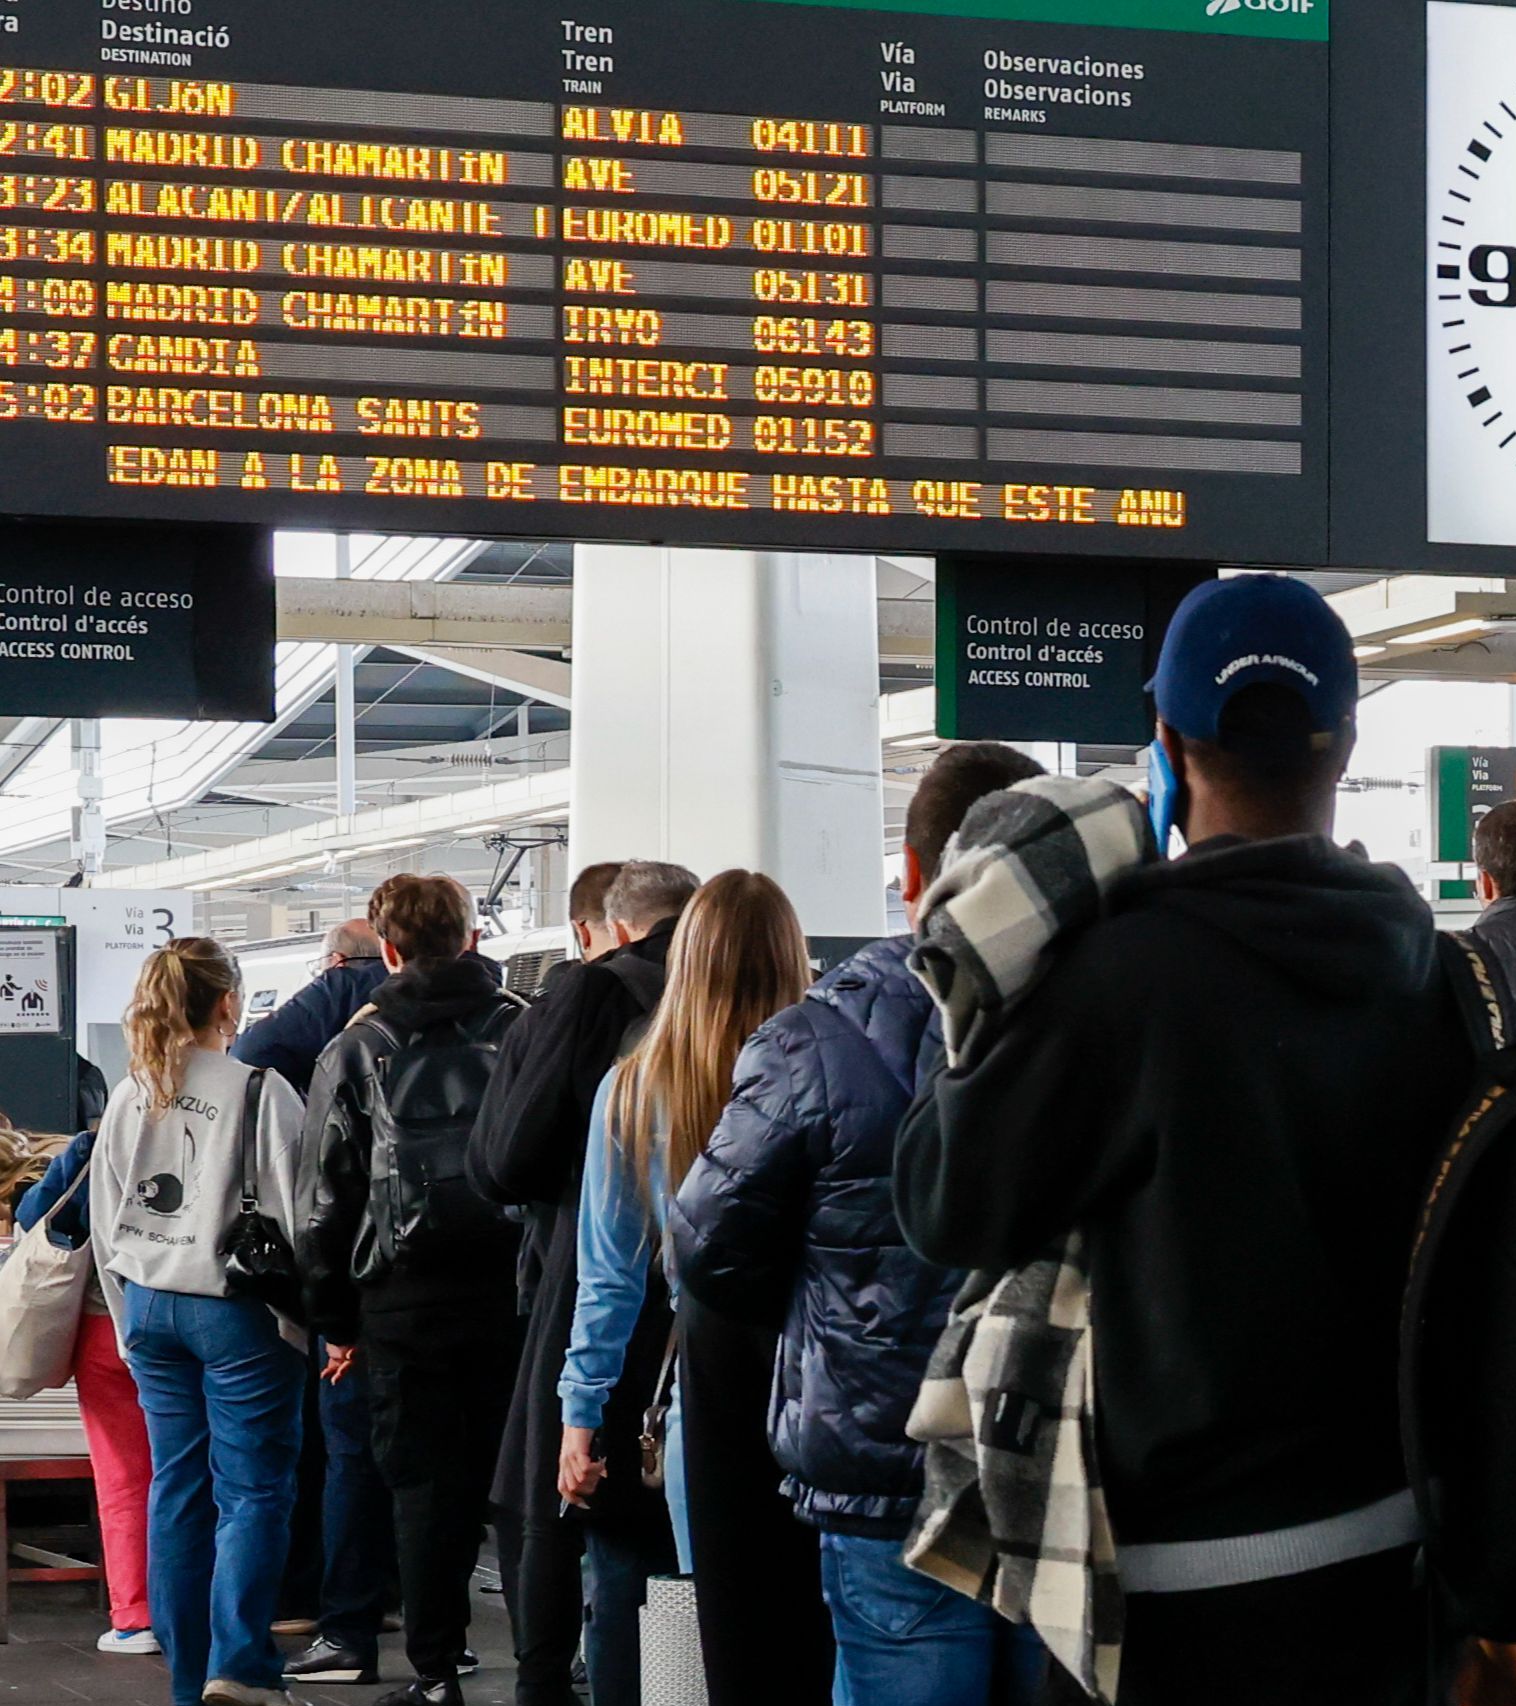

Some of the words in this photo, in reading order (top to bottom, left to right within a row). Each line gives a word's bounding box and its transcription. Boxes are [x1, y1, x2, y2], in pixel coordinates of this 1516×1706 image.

[103, 20, 229, 47] Destinació
[561, 21, 612, 43] Tren
[102, 48, 191, 66] DESTINATION
[562, 50, 612, 72] Tren
[881, 42, 914, 64] Vía
[985, 51, 1143, 79] Observaciones
[563, 80, 601, 93] TRAIN
[881, 71, 914, 92] Via
[985, 79, 1131, 106] Observacions
[881, 100, 945, 116] PLATFORM
[985, 107, 1045, 122] REMARKS
[564, 108, 682, 145] ALVIA
[753, 120, 866, 156] 04111
[107, 130, 258, 169] MADRID
[565, 158, 634, 192] AVE
[755, 170, 867, 206] 05121
[564, 209, 730, 248] EUROMED
[753, 220, 866, 256] 01101
[108, 234, 258, 272] MADRID
[566, 260, 635, 293] AVE
[755, 270, 868, 305] 05131
[107, 282, 259, 324] MADRID
[565, 307, 660, 345] IRYO
[754, 317, 871, 356] 06143
[567, 357, 728, 399] INTERCI
[755, 366, 872, 405] 05910
[108, 387, 333, 431] BARCELONA
[358, 398, 480, 438] SANTS
[565, 408, 730, 449] EUROMED
[755, 417, 871, 455] 01152
[242, 457, 267, 488] A
[292, 454, 340, 491] LA
[366, 458, 464, 496] ZONA
[487, 463, 535, 499] DE
[560, 466, 750, 508] EMBARQUE
[773, 476, 890, 513] HASTA
[913, 481, 981, 517] QUE
[1005, 485, 1095, 522] ESTE
[84, 587, 111, 606] de
[121, 592, 192, 608] acceso
[76, 615, 148, 634] d'accés
[967, 615, 1037, 635] Control
[1047, 618, 1070, 637] de
[1079, 623, 1143, 639] acceso
[0, 642, 54, 657] ACCESS
[61, 644, 134, 660] CONTROL
[967, 643, 1031, 660] Control
[1038, 645, 1103, 663] d'accés
[969, 670, 1019, 685] ACCESS
[1025, 672, 1090, 687] CONTROL
[1472, 757, 1488, 768] Vía
[1472, 770, 1489, 780] Via
[126, 907, 144, 918] Vía
[125, 924, 144, 935] Via
[152, 909, 174, 949] 3
